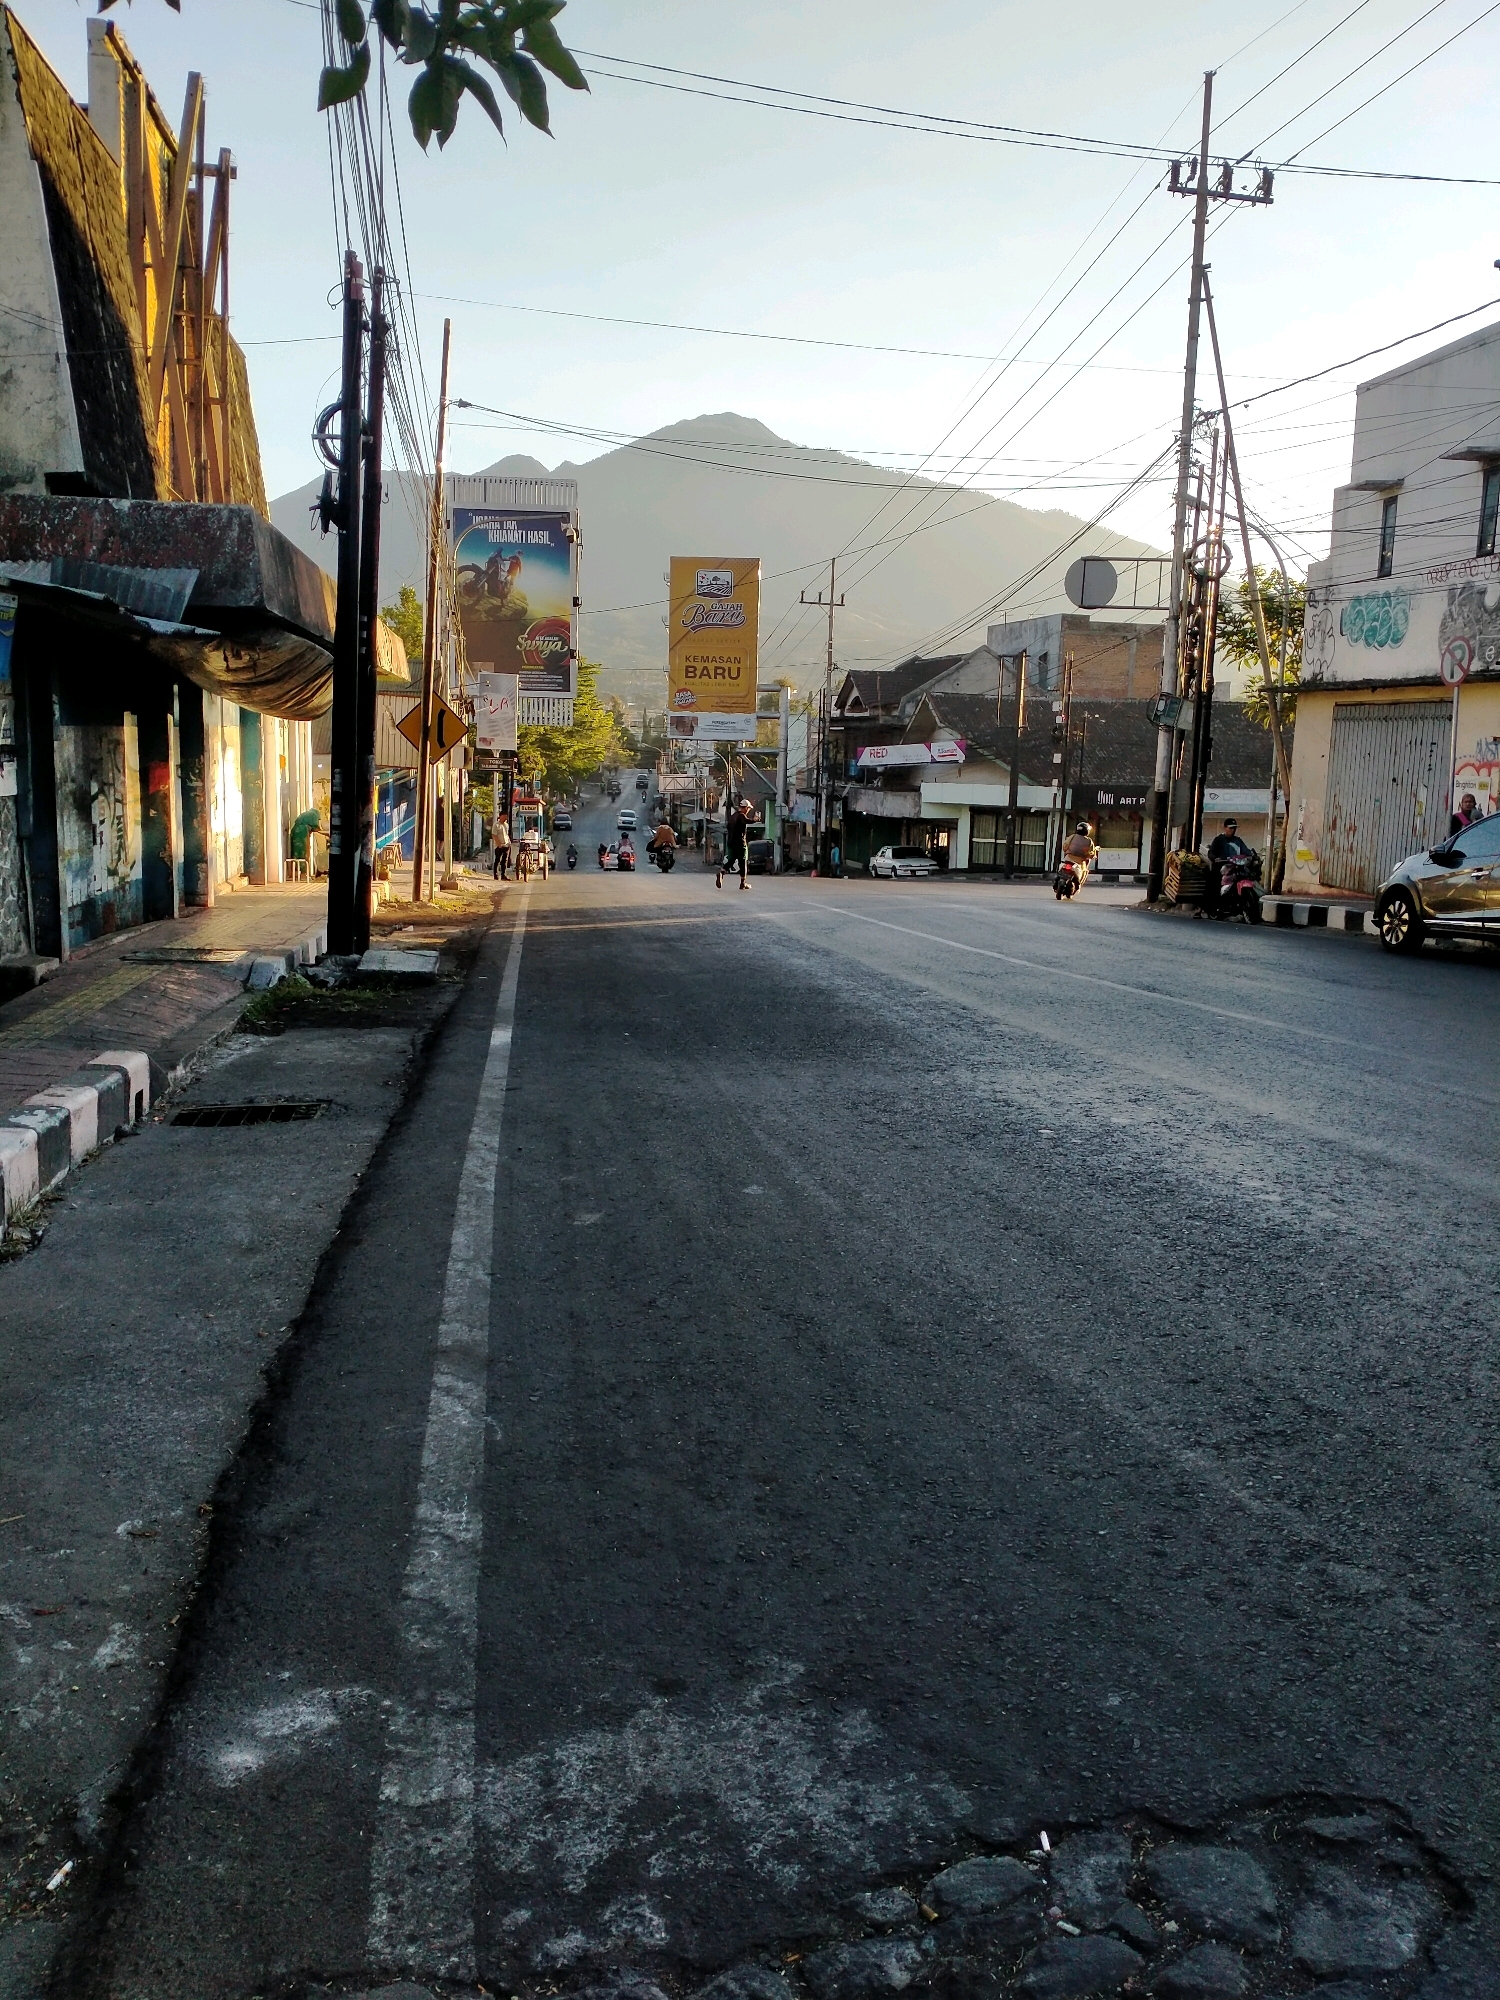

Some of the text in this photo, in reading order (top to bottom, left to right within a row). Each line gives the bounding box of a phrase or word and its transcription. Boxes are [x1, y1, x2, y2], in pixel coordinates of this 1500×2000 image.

[488, 529, 526, 544] KHIANATI
[711, 602, 744, 611] GAJAH
[682, 603, 747, 633] Baru
[516, 634, 569, 658] Surya
[685, 654, 742, 665] KEMASAN
[1450, 643, 1467, 680] P
[684, 664, 741, 681] BARU
[869, 747, 888, 760] RED
[1119, 797, 1138, 805] ART
